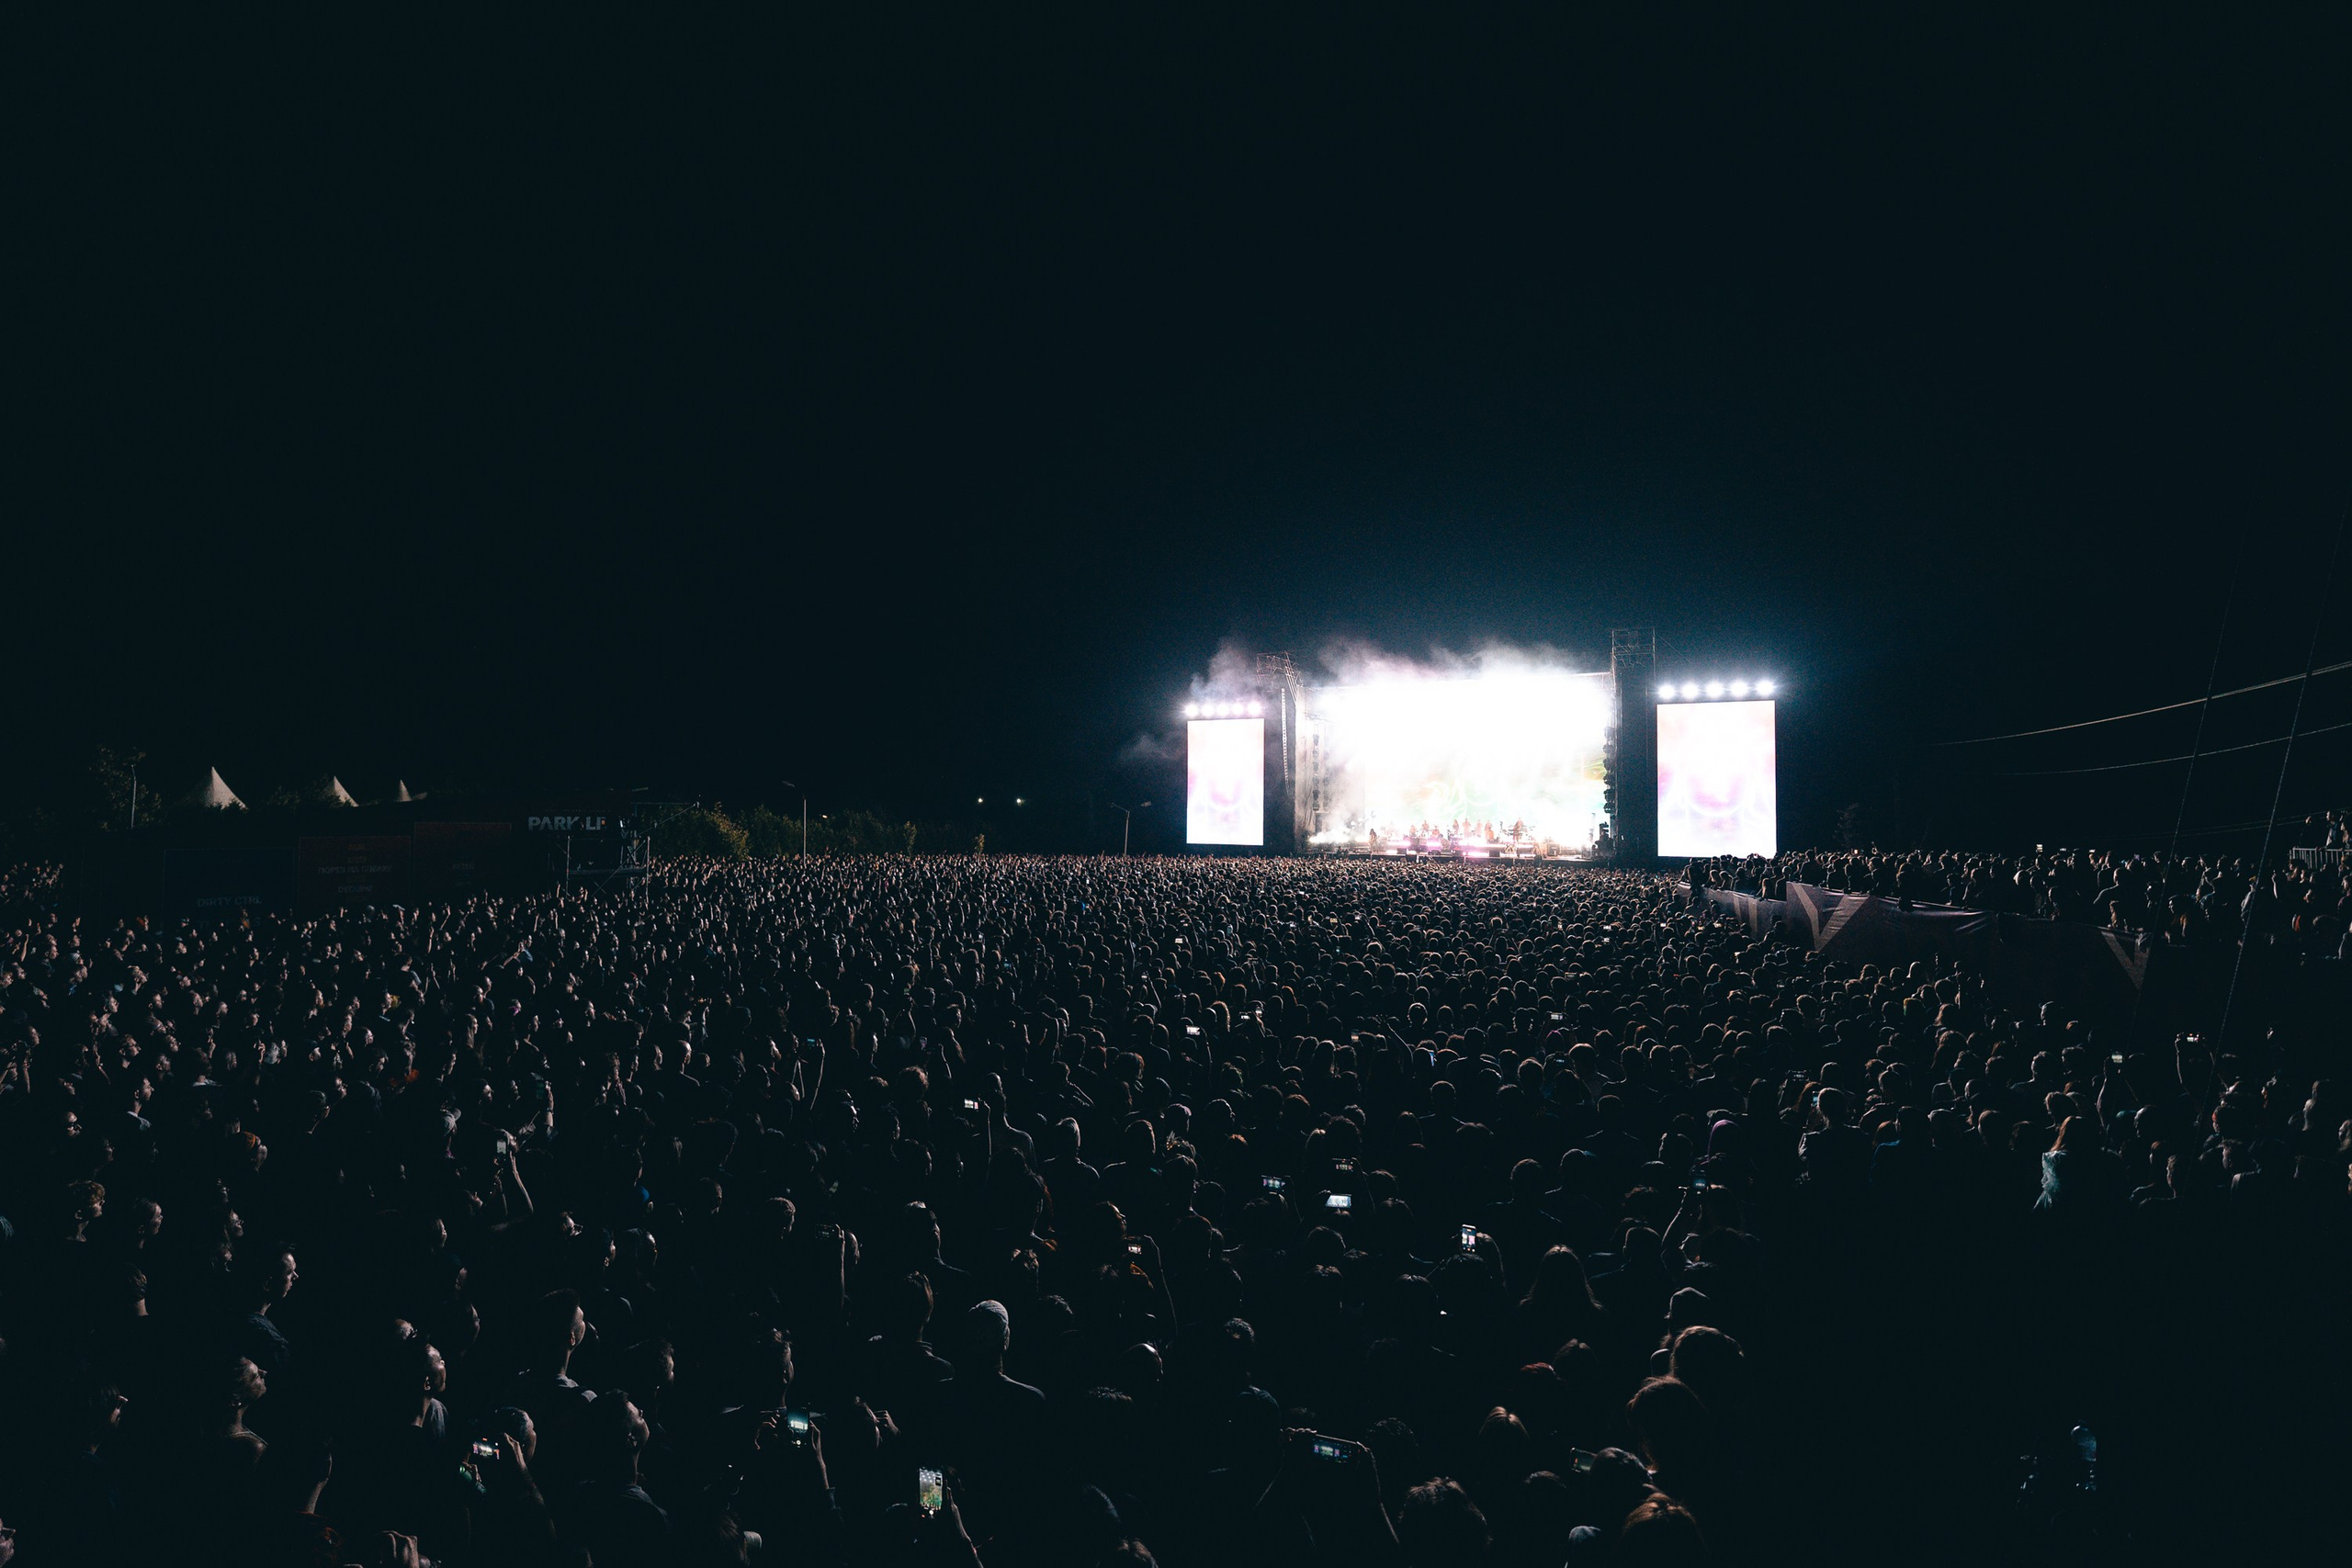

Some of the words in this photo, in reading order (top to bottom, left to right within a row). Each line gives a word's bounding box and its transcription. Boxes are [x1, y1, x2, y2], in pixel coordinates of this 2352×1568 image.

[527, 816, 580, 831] PARK
[197, 897, 232, 908] DIRTY
[233, 896, 263, 906] CTRL
